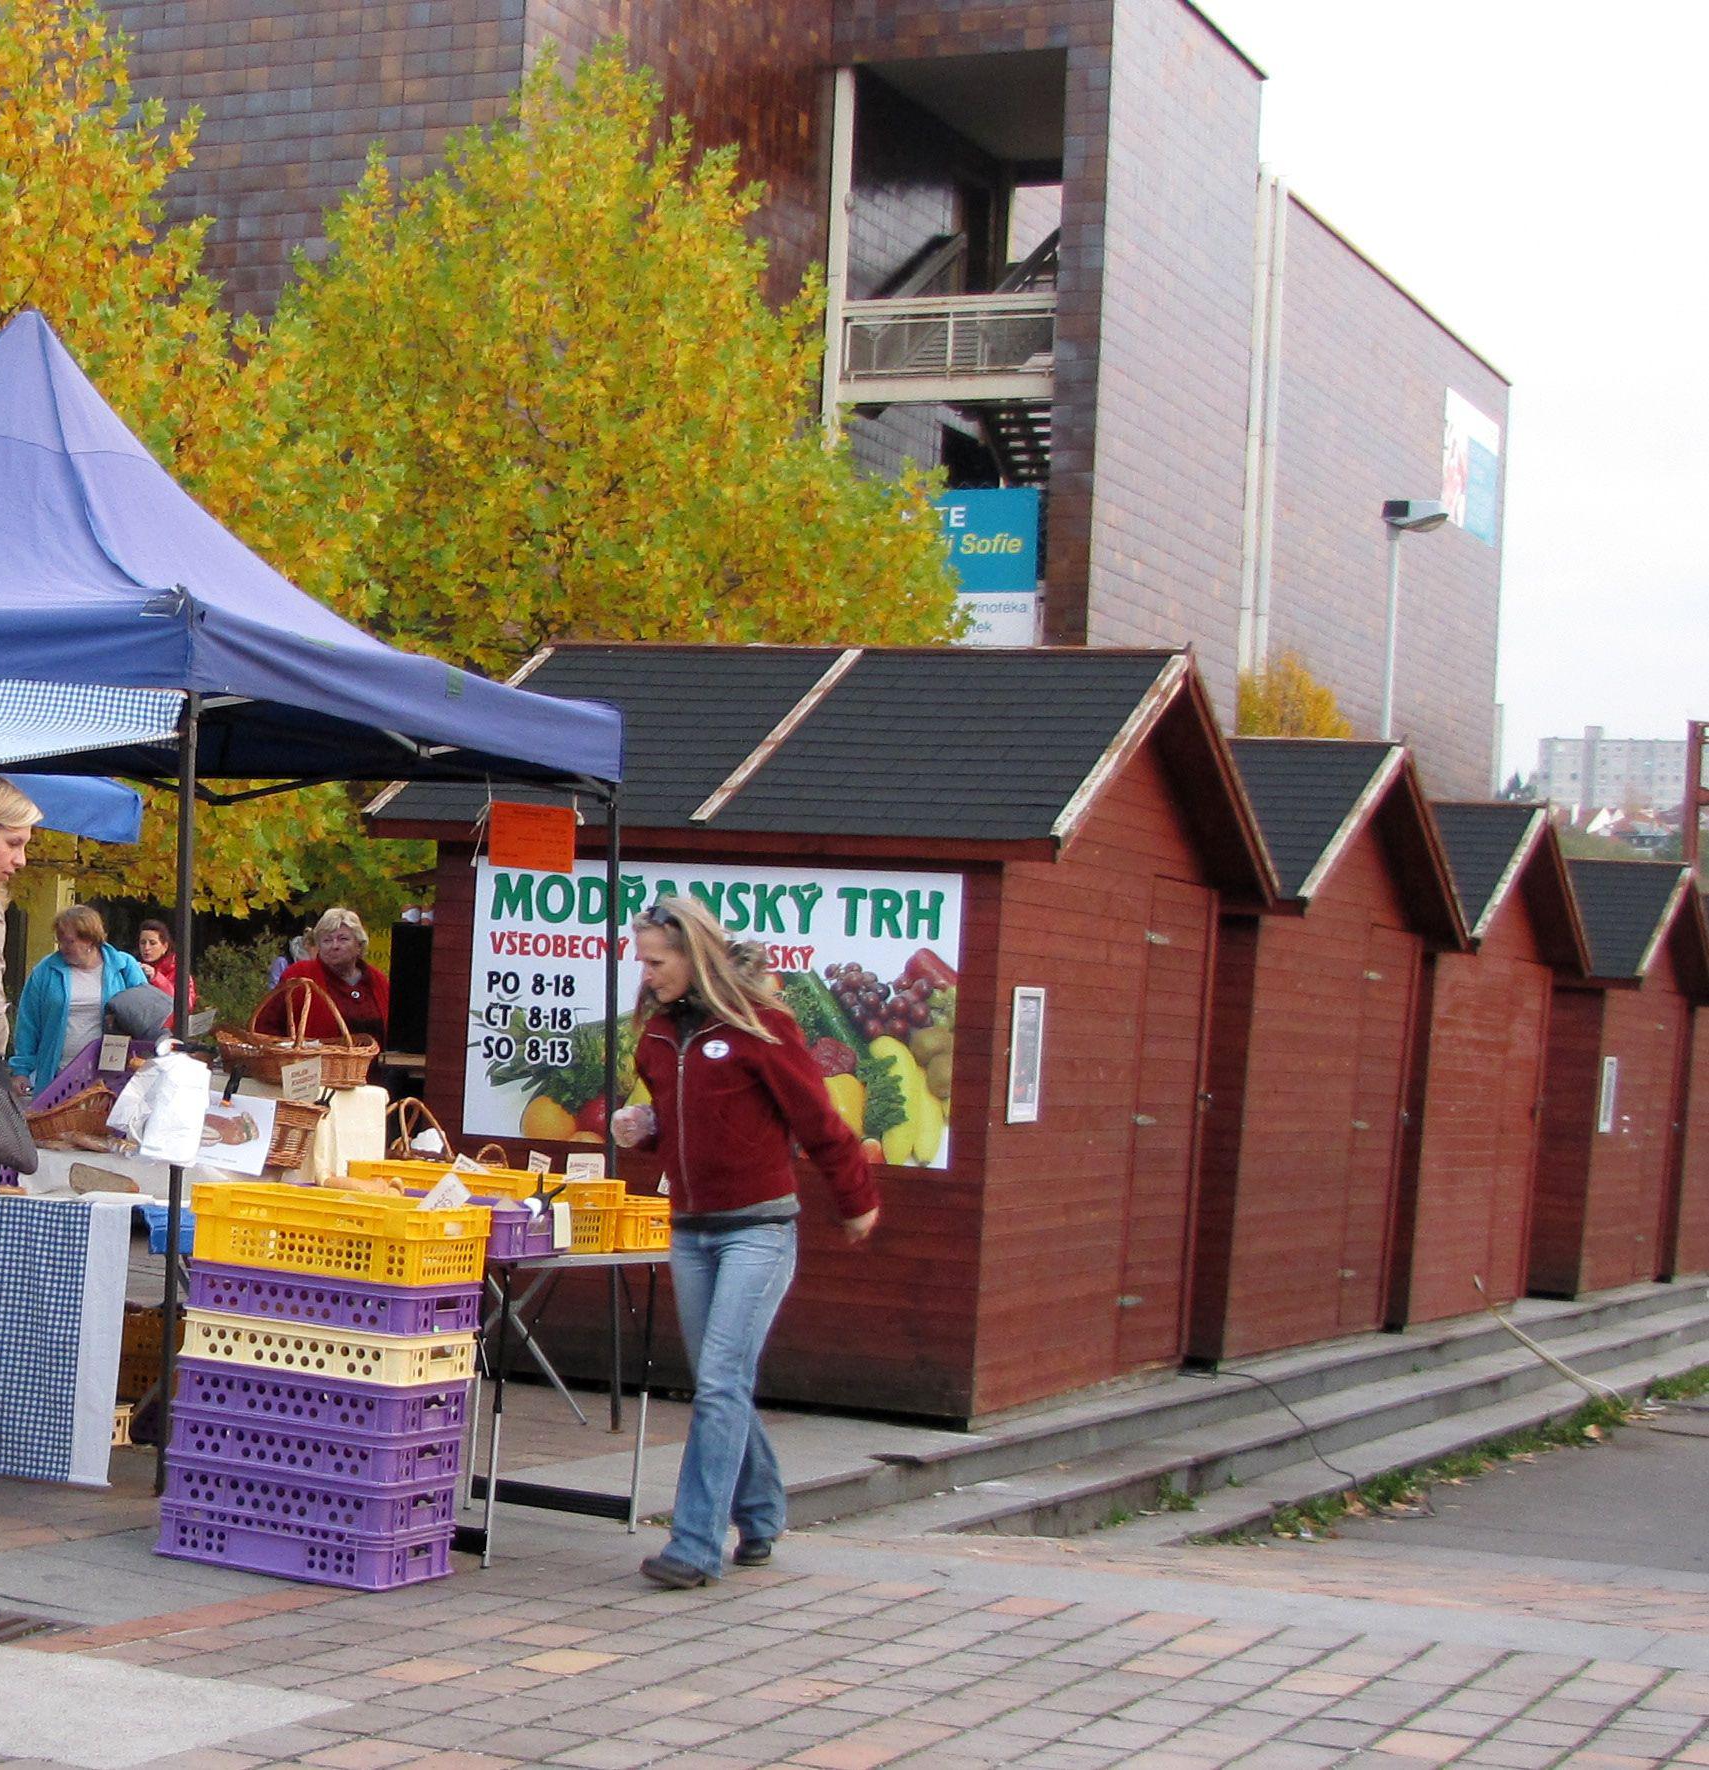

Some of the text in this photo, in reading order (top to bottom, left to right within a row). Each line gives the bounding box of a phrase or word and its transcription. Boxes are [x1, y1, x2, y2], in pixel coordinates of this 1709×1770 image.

[960, 533, 1022, 555] Sofie
[837, 886, 945, 940] TRH
[766, 944, 815, 970] SKÝ
[487, 970, 575, 998] PO 8-18
[484, 1001, 572, 1031] ČT 8-18
[482, 1035, 570, 1064] SO 8-13
